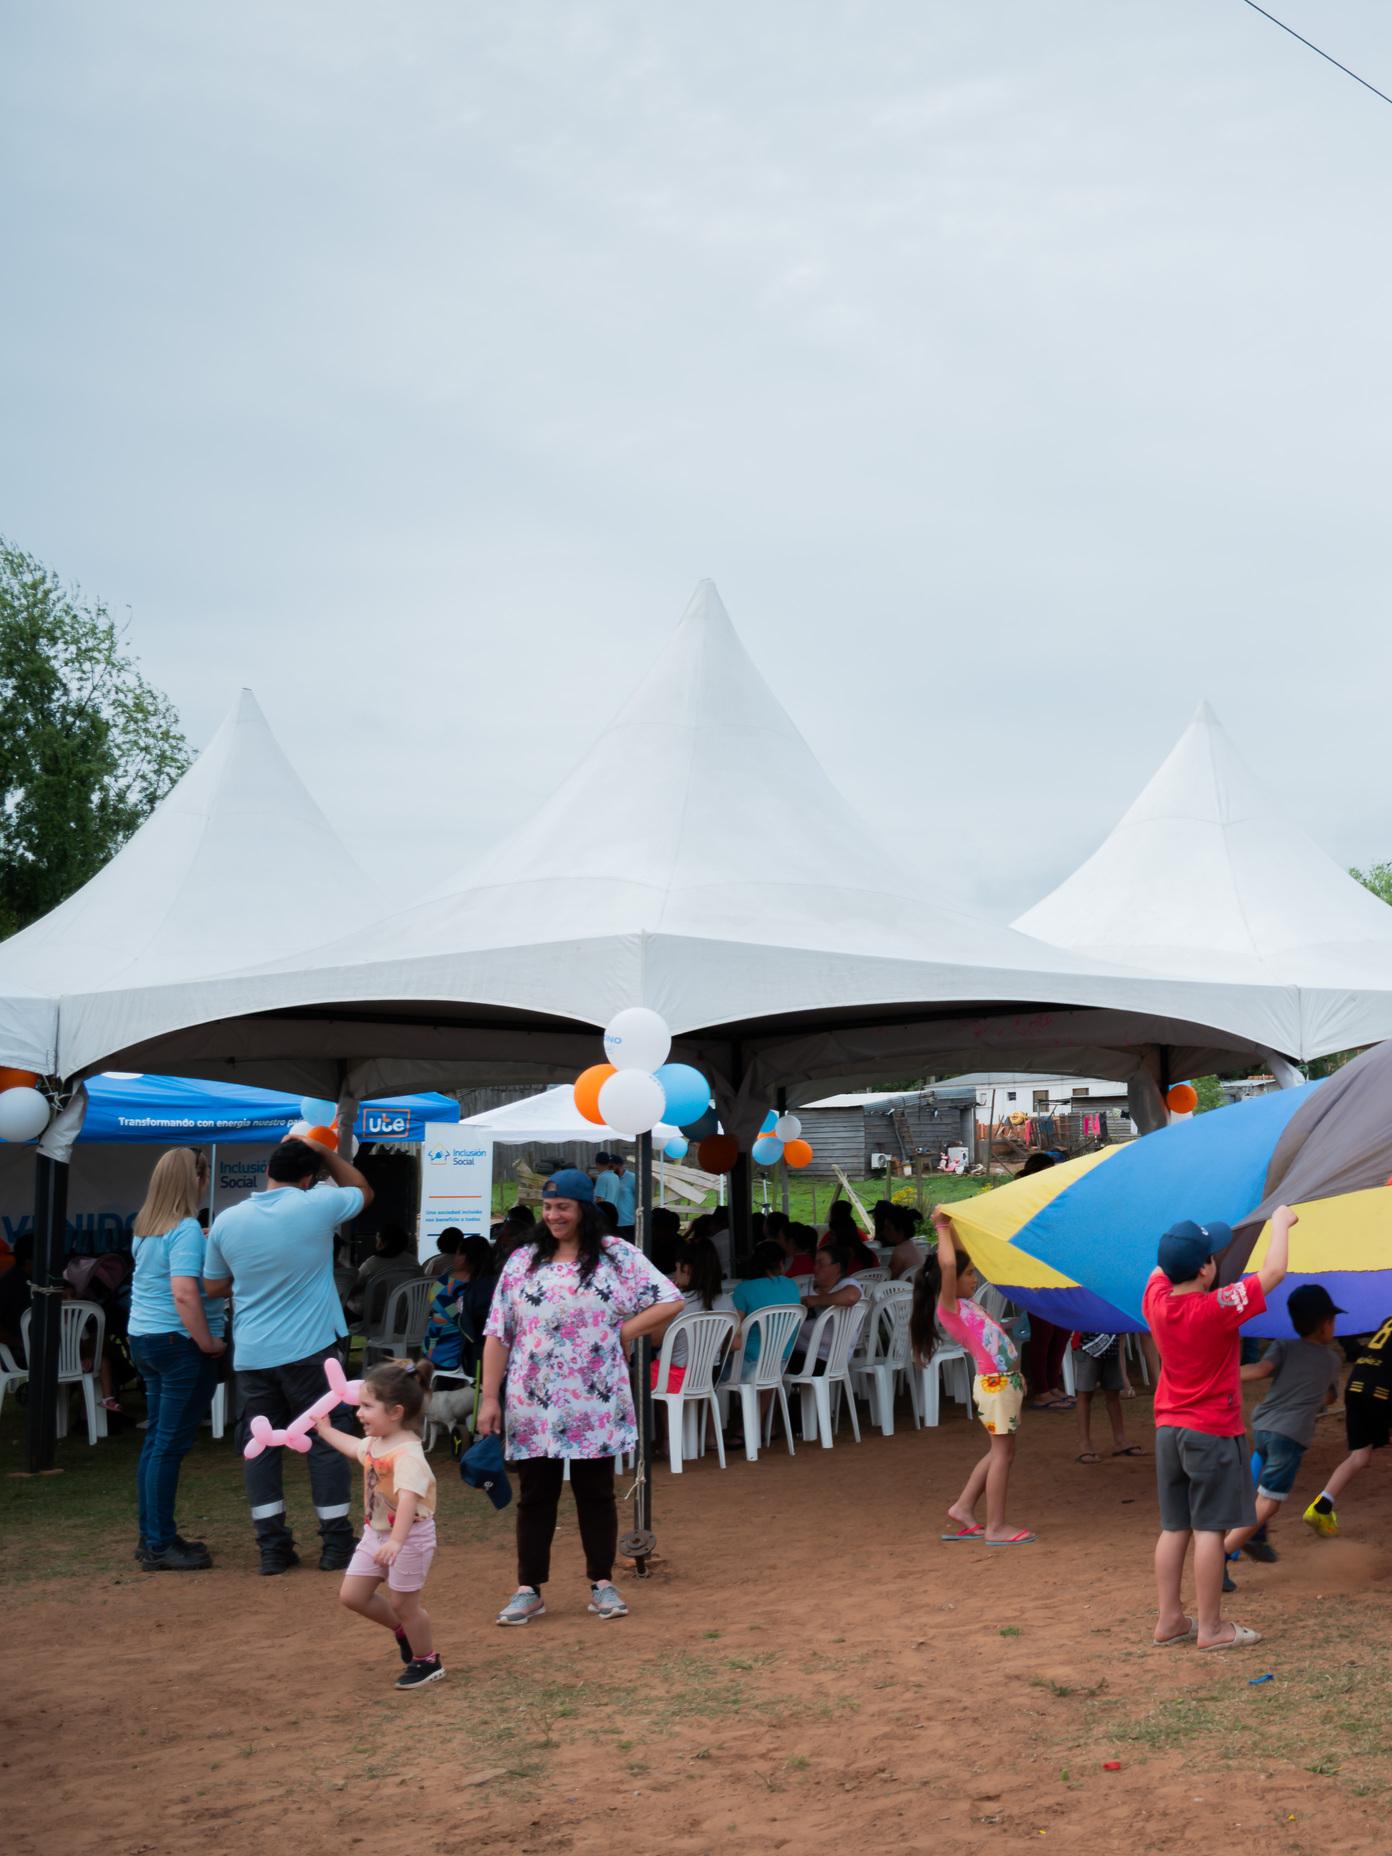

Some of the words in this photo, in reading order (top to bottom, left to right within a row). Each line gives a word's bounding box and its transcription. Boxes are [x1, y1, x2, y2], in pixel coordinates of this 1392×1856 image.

[118, 1116, 195, 1128] Transformando
[197, 1119, 215, 1128] con
[369, 1113, 405, 1133] ute
[453, 1148, 487, 1157] Inclusión
[220, 1161, 268, 1174] Inclusió
[453, 1158, 475, 1166] Social
[220, 1176, 257, 1188] Social
